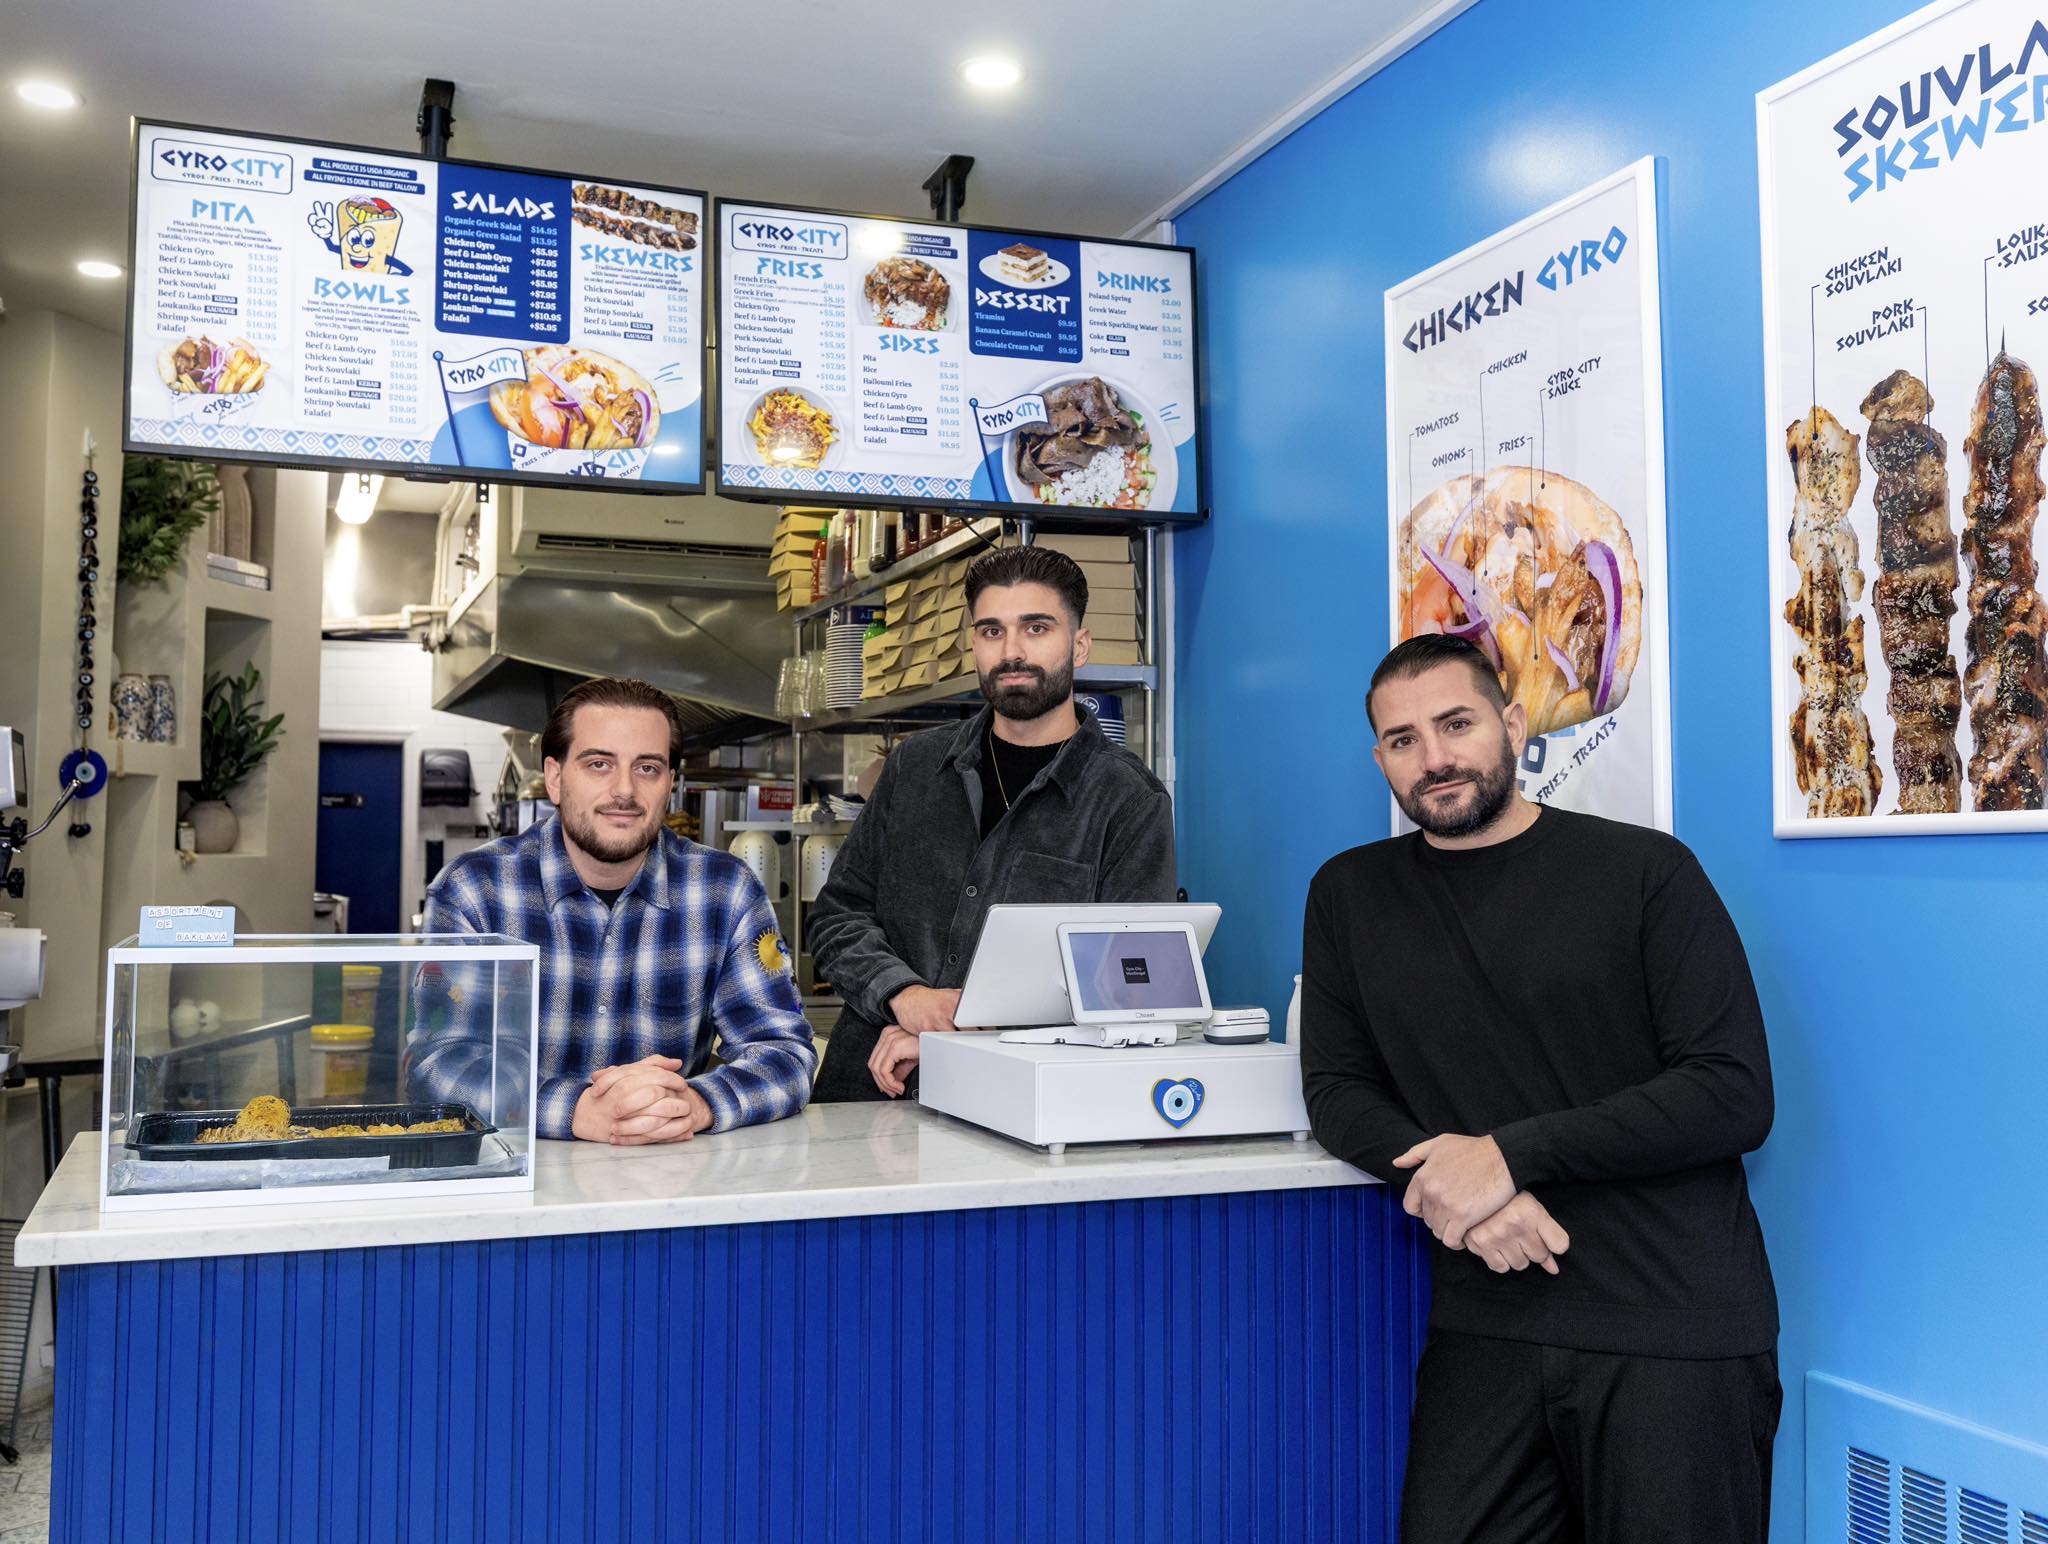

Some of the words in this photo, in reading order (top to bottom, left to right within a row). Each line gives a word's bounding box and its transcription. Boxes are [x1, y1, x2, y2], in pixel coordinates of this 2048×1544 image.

[160, 149, 228, 172] GYRO
[230, 158, 285, 180] CITY
[332, 162, 359, 171] PRODUCE
[384, 169, 410, 177] ORGANIC
[182, 172, 205, 180] GYROS
[210, 175, 231, 183] FRIES
[237, 179, 263, 187] TREATS
[324, 175, 345, 183] FRYING
[354, 178, 370, 186] DONE
[394, 183, 417, 192] TALLOW
[191, 198, 256, 225] PITA
[451, 190, 556, 221] SALADS
[445, 215, 474, 225] Organic
[476, 219, 498, 228] Greek
[500, 222, 522, 231] Salad
[445, 226, 474, 237] Organic
[476, 230, 499, 239] Green
[500, 233, 522, 242] Salad
[531, 226, 558, 236] $14.95
[739, 222, 794, 242] GYRO
[797, 227, 840, 246] CITY
[444, 237, 476, 248] Chicken
[477, 241, 495, 250] Gyro
[531, 237, 557, 246] $13.95
[1997, 223, 2048, 254] LOUK
[159, 244, 193, 253] Chicken
[194, 248, 214, 256] Gyro
[444, 248, 462, 257] Beef
[471, 251, 492, 260] Lamb
[493, 254, 512, 263] Gyro
[531, 247, 558, 257] +$5.95
[159, 255, 177, 263] Beef
[189, 258, 212, 266] Lamb
[213, 261, 233, 269] Gyro
[531, 258, 557, 268] +$7.95
[580, 244, 693, 273] SKEWERS
[1824, 246, 1888, 281] CHICKEN
[159, 266, 192, 276] Chicken
[194, 270, 230, 280] Souvlaki
[444, 259, 476, 269] Chicken
[476, 262, 509, 273] Souvlaki
[757, 257, 824, 280] FRIES
[444, 270, 462, 279] Pork
[464, 272, 497, 282] Souvlaki
[531, 268, 558, 279] +$5.95
[1825, 257, 1902, 298] SOUVLAKI
[158, 278, 178, 286] Pork
[181, 280, 216, 290] Souvlaki
[444, 281, 473, 292] Shrimp
[474, 284, 508, 294] Souvlaki
[530, 279, 558, 289] +$5.95
[1097, 271, 1172, 294] DRINKS
[1402, 270, 1524, 354] CHICKEN
[1536, 225, 1627, 291] GYRO
[314, 277, 411, 307] BOWLS
[530, 290, 557, 300] +$7.95
[734, 288, 754, 296] Greek
[1089, 292, 1108, 300] Poland
[1109, 294, 1132, 303] Spring
[158, 301, 202, 311] Loukaniko
[443, 303, 484, 314] Loukaniko
[530, 301, 556, 311] +$7.95
[976, 288, 1071, 315] DESSERT
[157, 312, 189, 323] Shrimp
[191, 315, 227, 325] Souvlaki
[443, 314, 470, 323] Falafel
[530, 312, 561, 322] +$10.95
[975, 312, 1005, 321] Tiramisu
[1872, 298, 1914, 325] PORK
[157, 324, 185, 333] Falafel
[530, 322, 557, 332] +$5.95
[975, 326, 1000, 335] Banana
[1001, 329, 1028, 337] Caramel
[1029, 331, 1052, 339] Crunch
[1109, 322, 1138, 331] Sparkling
[1836, 313, 1914, 352] SOUVLAKI
[1058, 333, 1077, 341] $9.95
[879, 334, 940, 355] SIDES
[976, 340, 1007, 349] Chocolate
[1008, 343, 1029, 351] Cream
[1059, 347, 1077, 355] $9.95
[1487, 350, 1527, 375] CHICKEN
[447, 364, 485, 385] GYRO
[487, 356, 518, 373] CITY
[1547, 367, 1574, 387] GYRO
[1577, 356, 1601, 374] CITY
[864, 378, 894, 386] Halloumi
[1548, 377, 1581, 400] SAUCE
[982, 409, 1014, 428] GYRO
[1015, 401, 1041, 417] CITY
[864, 425, 899, 433] Loukaniko
[1415, 412, 1460, 437] TOMATOES
[1499, 436, 1526, 455] FRIES
[1432, 448, 1466, 468] ONIONS
[1536, 768, 1569, 804] FRIES
[1572, 716, 1617, 766] TREATS
[149, 907, 223, 917] ASSORTMENT
[157, 920, 172, 928] OF
[176, 933, 228, 941] BAKLAVA
